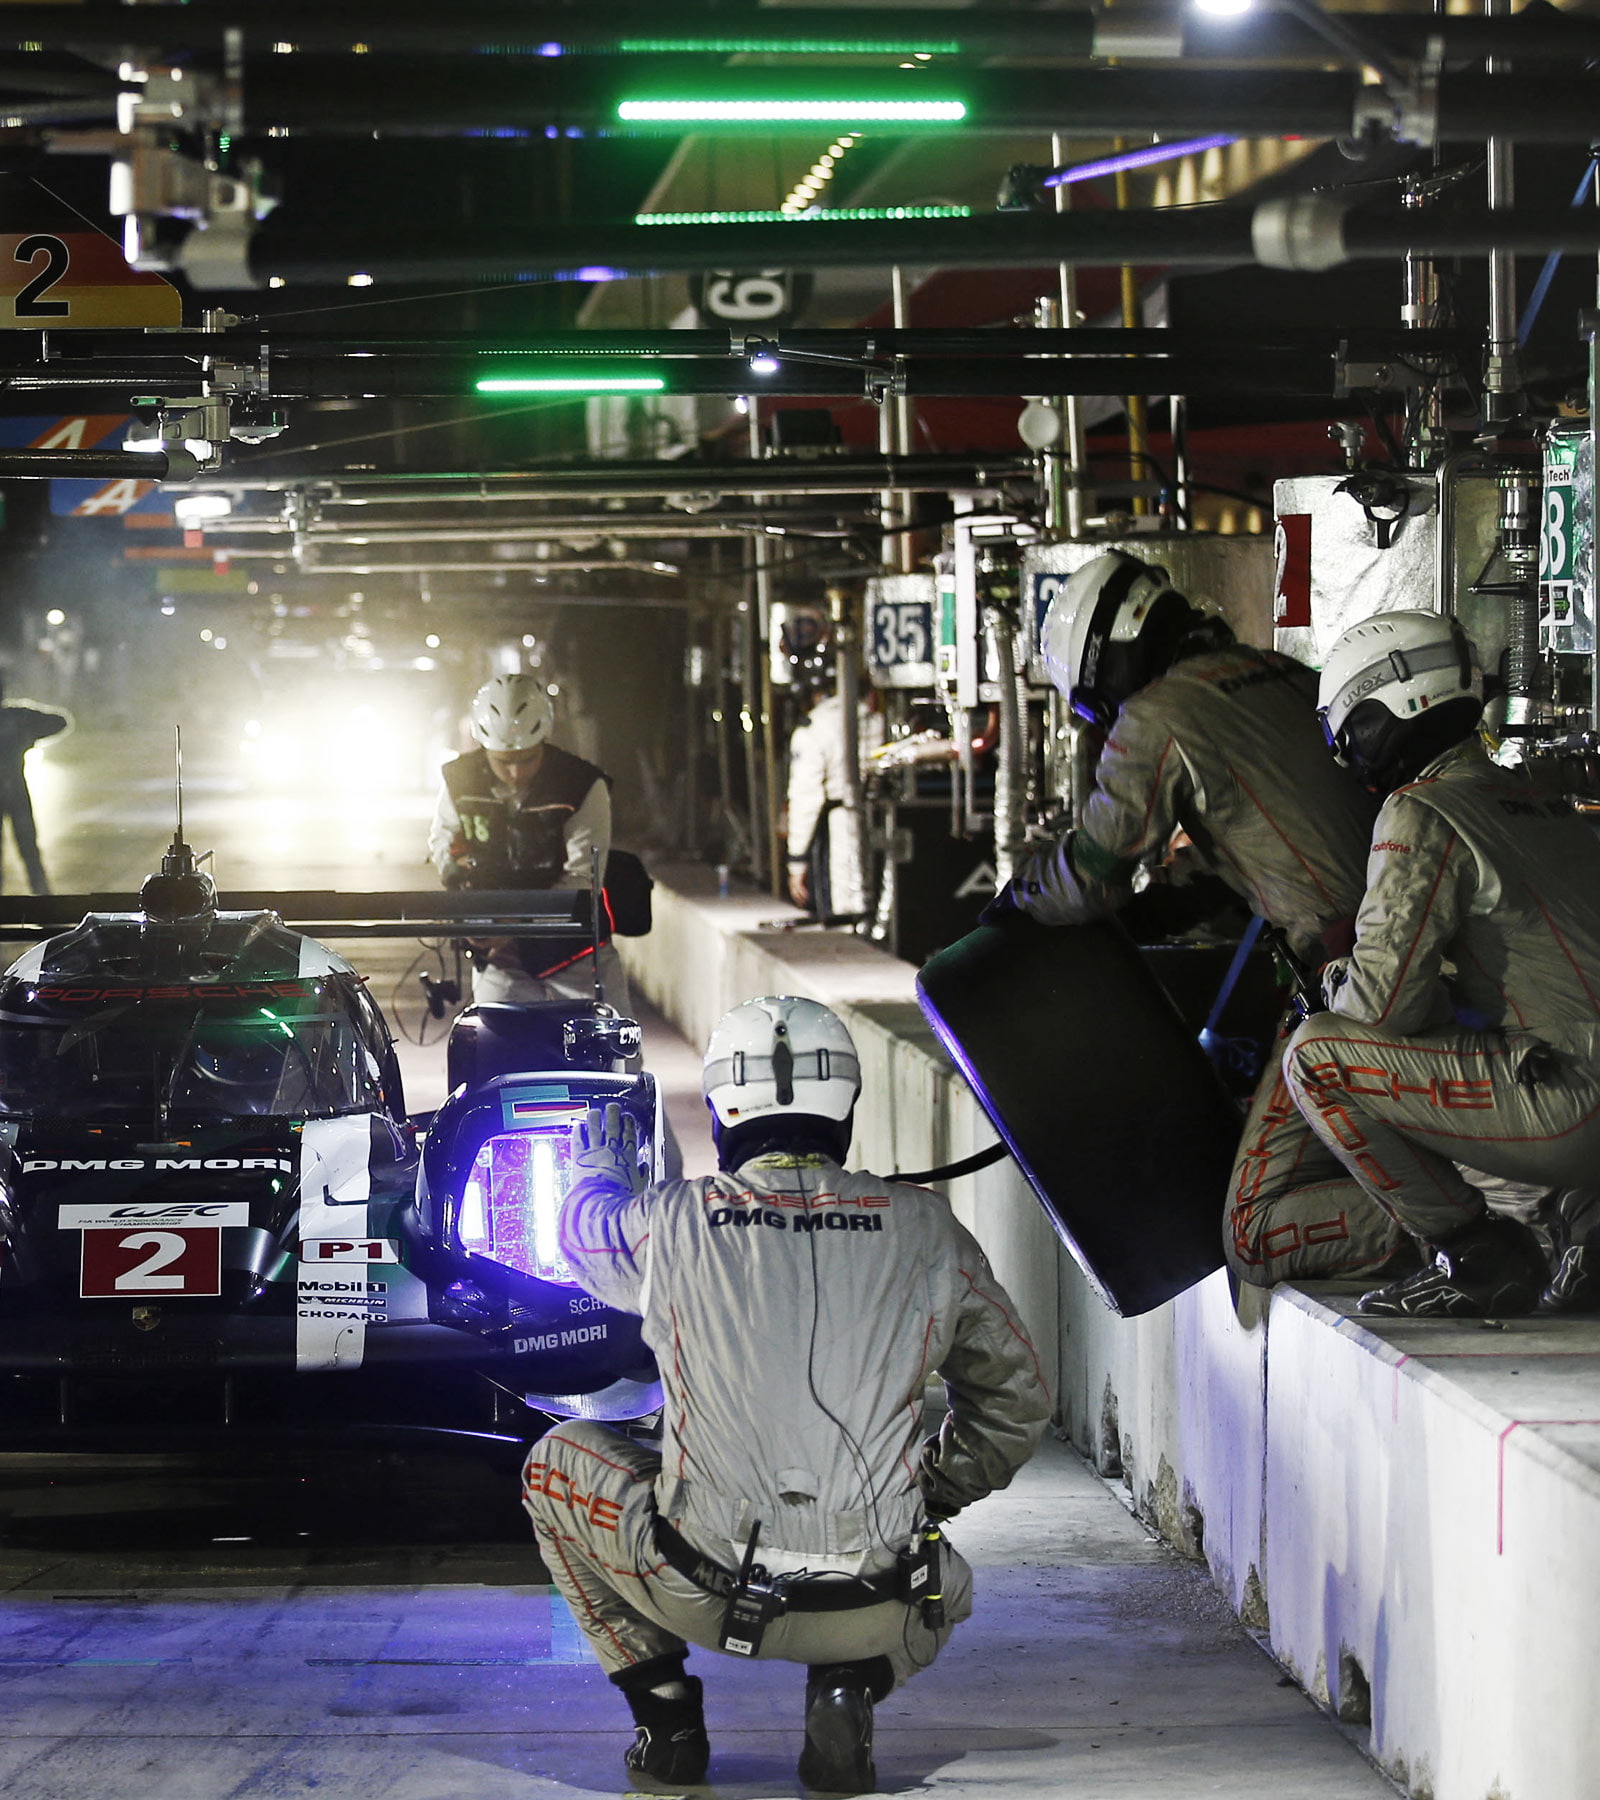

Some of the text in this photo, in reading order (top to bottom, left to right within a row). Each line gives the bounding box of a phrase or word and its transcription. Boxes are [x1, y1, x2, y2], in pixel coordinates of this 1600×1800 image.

[13, 233, 70, 317] 2
[876, 605, 926, 664] 35
[1342, 671, 1386, 709] uvex
[35, 984, 311, 1001] PORSCHE
[23, 1158, 291, 1174] DMG MORI
[109, 1204, 229, 1219] WEC
[710, 1208, 882, 1233] DMG MORI
[319, 1242, 382, 1259] P1
[115, 1231, 187, 1290] 2
[298, 1281, 362, 1292] Mobil
[323, 1297, 386, 1306] MICHELIN
[298, 1310, 387, 1322] CHOPARD
[513, 1324, 608, 1354] DMG MORI
